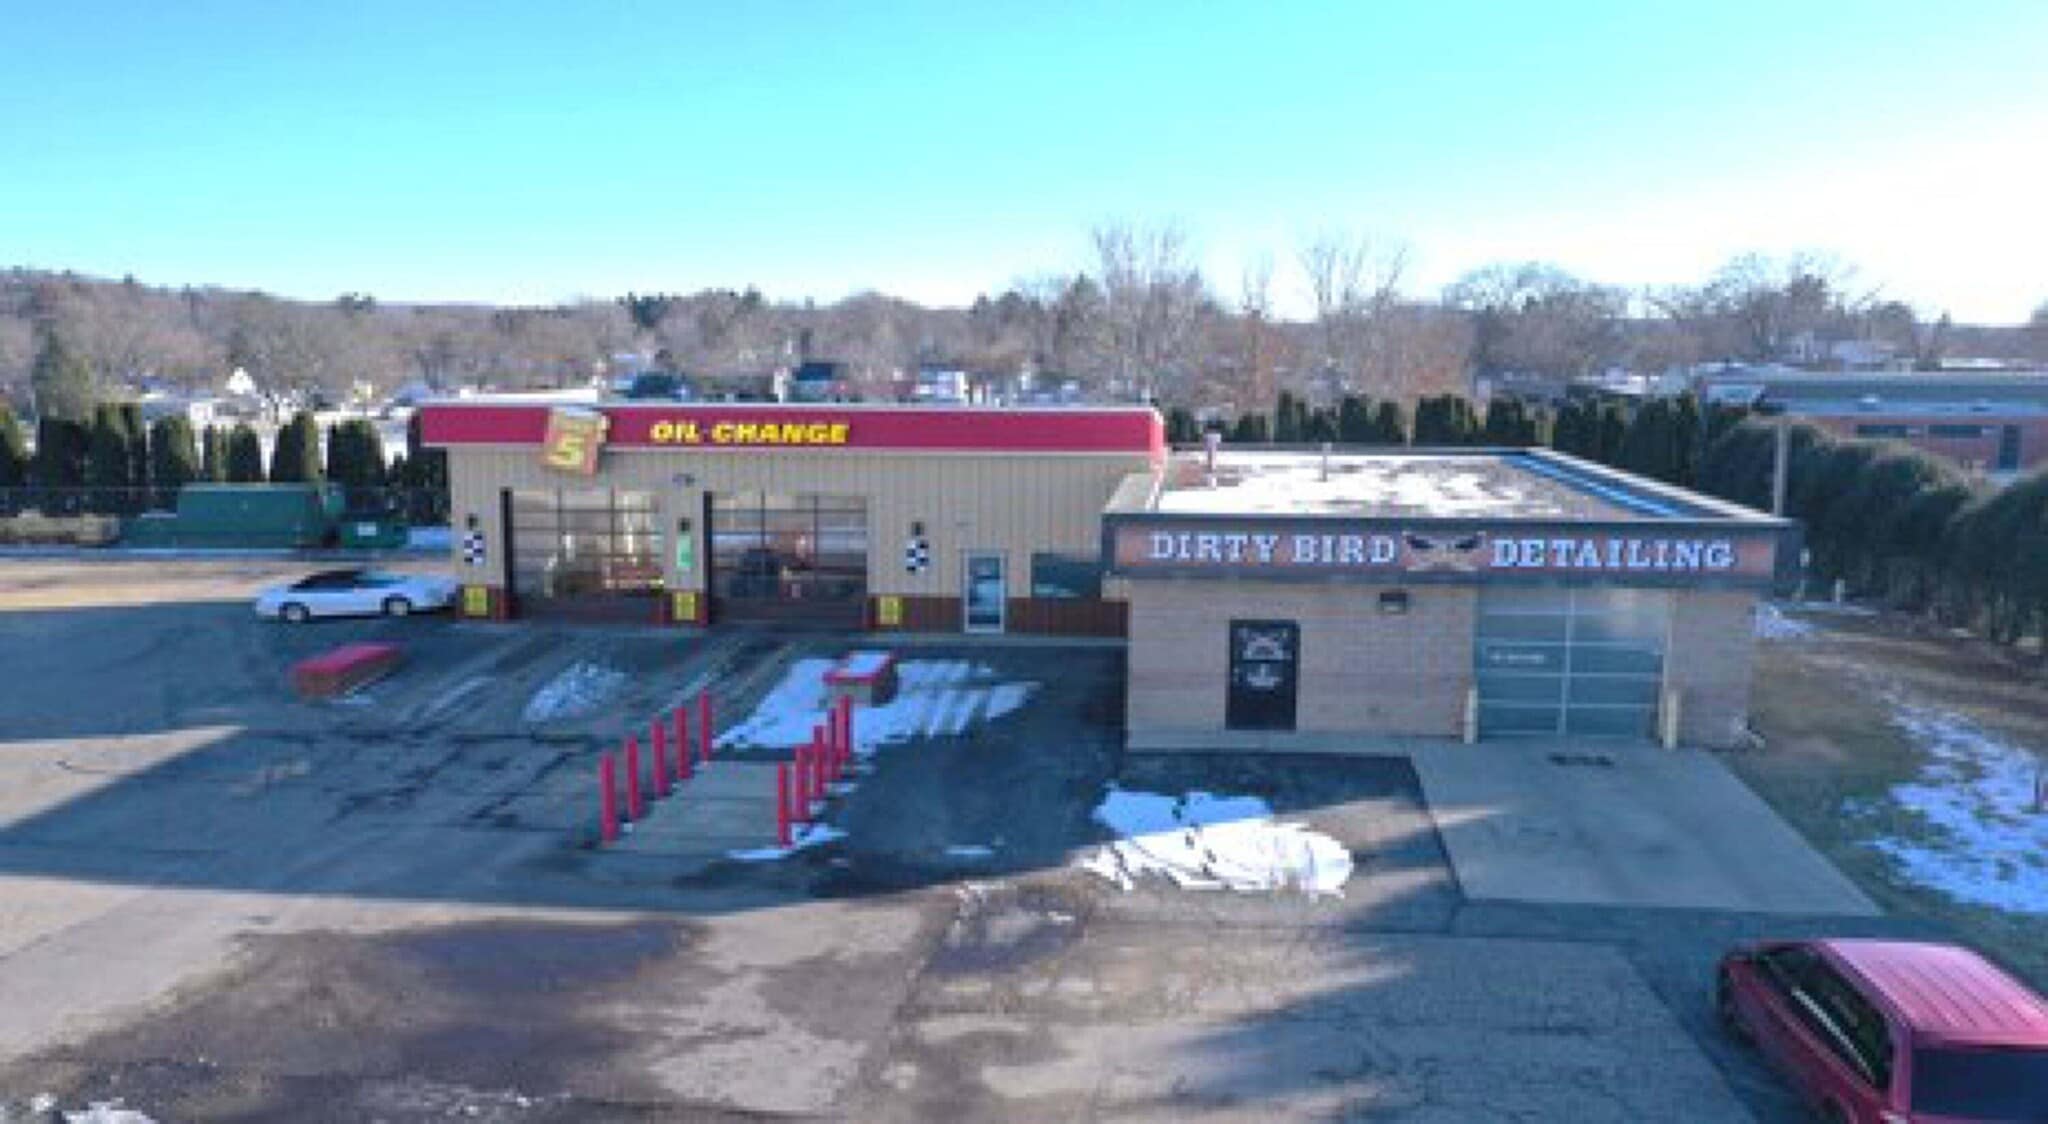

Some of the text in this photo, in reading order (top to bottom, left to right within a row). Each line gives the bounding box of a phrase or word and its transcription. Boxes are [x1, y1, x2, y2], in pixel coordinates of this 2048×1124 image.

[547, 432, 587, 467] 5
[650, 420, 850, 444] OIL CHANGE
[1150, 531, 1736, 569] DIRTY BIRD DETAILING
